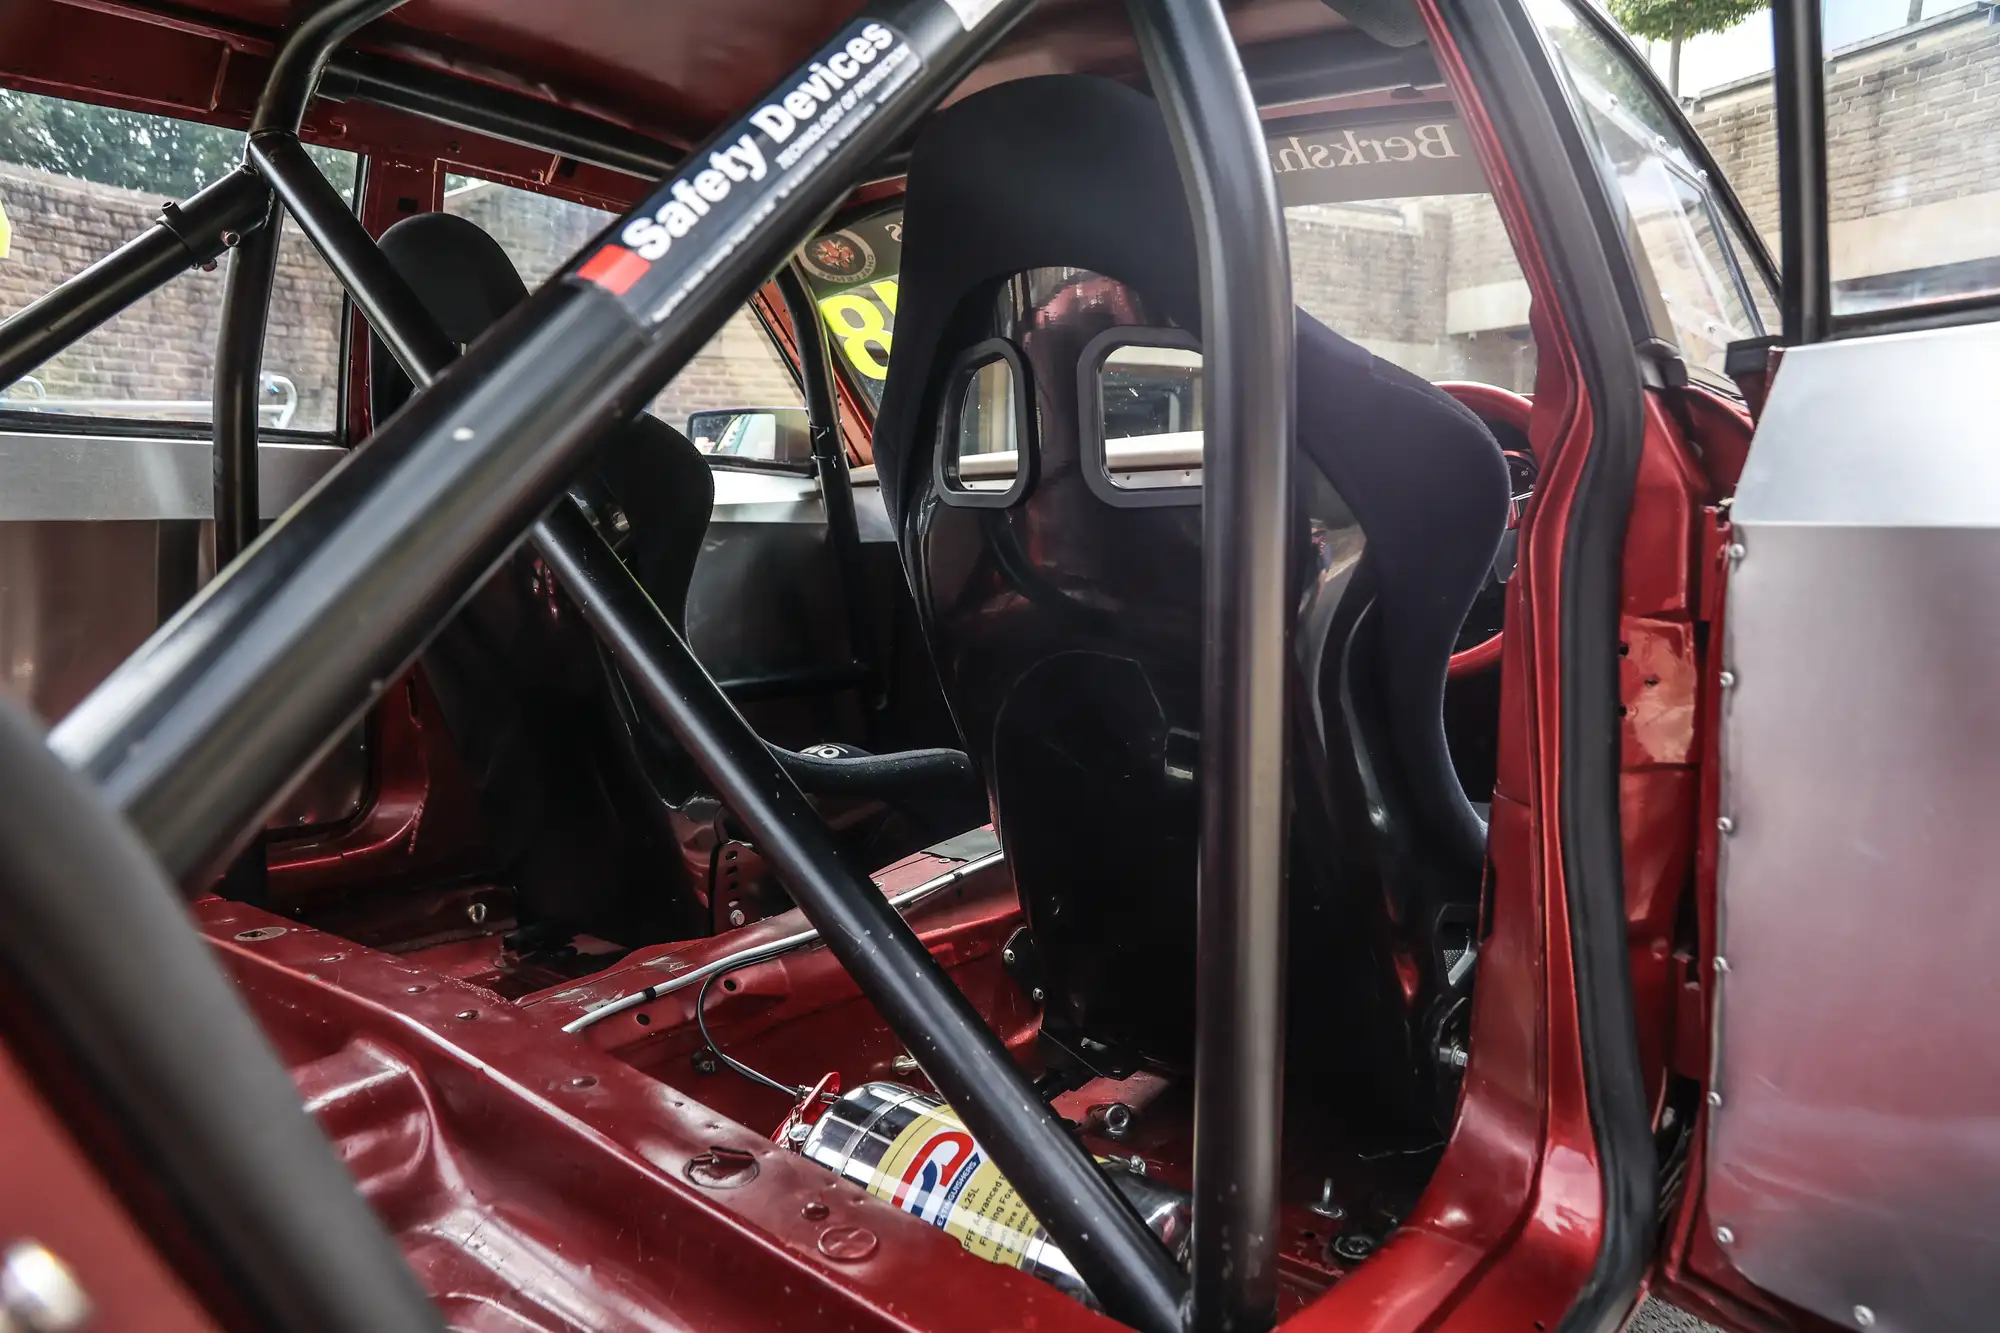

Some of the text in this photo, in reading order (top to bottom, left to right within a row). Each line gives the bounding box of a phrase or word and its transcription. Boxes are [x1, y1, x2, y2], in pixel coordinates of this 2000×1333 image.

[621, 133, 768, 260] Safety
[749, 23, 893, 143] Devices
[937, 1160, 977, 1226] EXTINGUISHERS
[973, 1181, 1003, 1226] Advanced
[999, 1188, 1016, 1205] Foa
